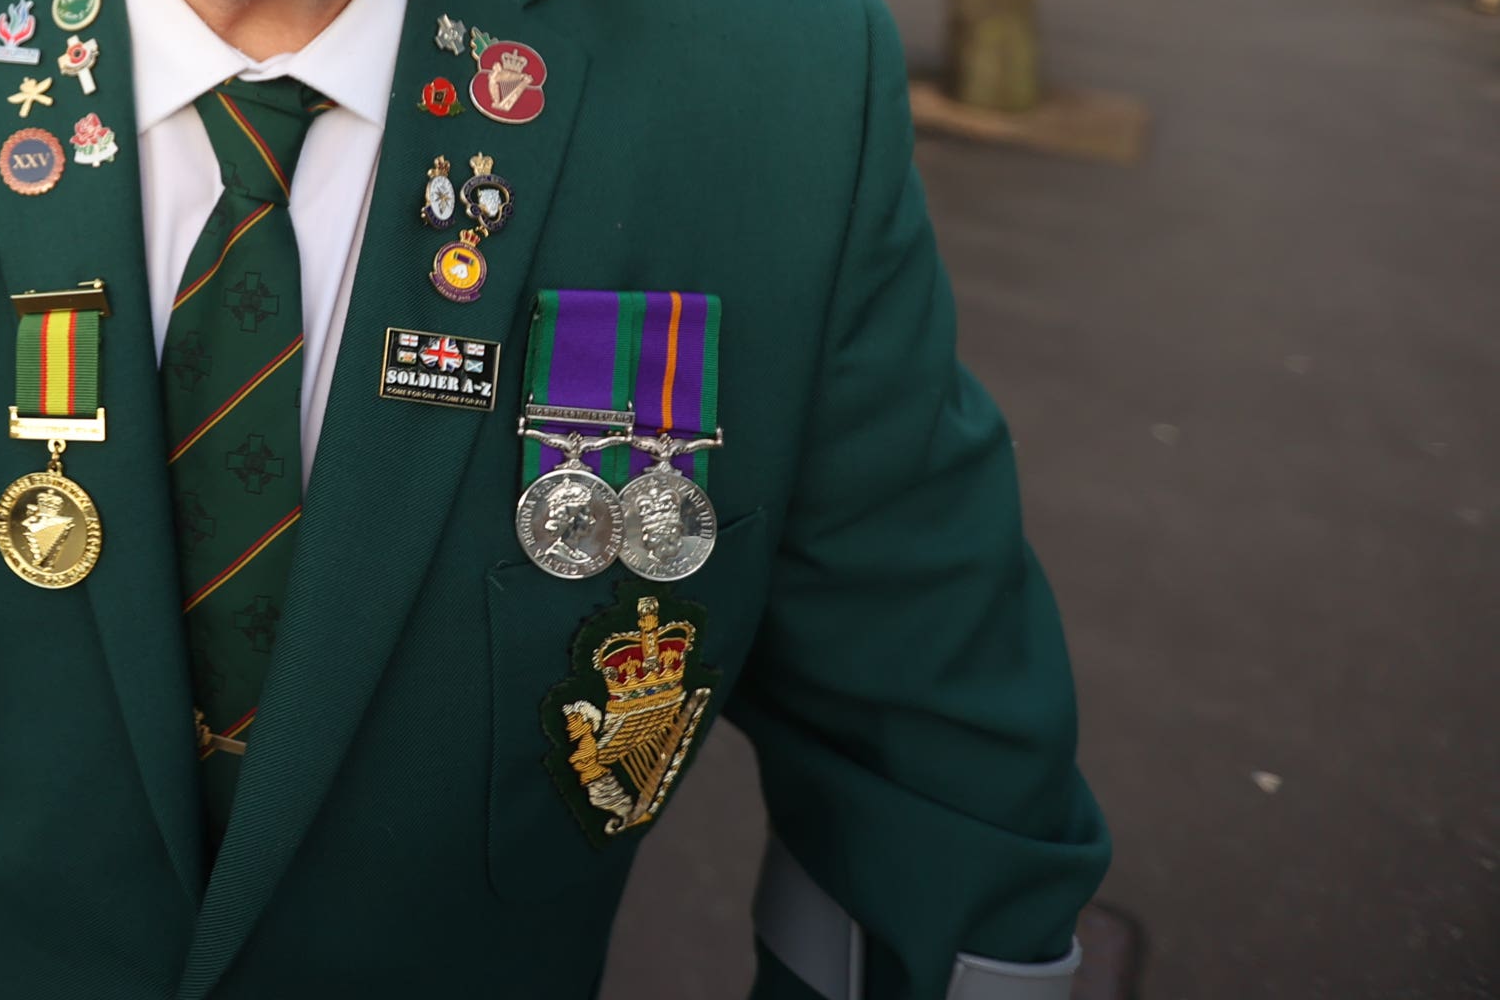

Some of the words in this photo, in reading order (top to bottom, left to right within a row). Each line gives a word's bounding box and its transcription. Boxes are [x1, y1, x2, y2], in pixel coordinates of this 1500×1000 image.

[12, 151, 50, 169] XXV
[386, 369, 459, 391] SOLDIER
[461, 377, 492, 397] A-Z
